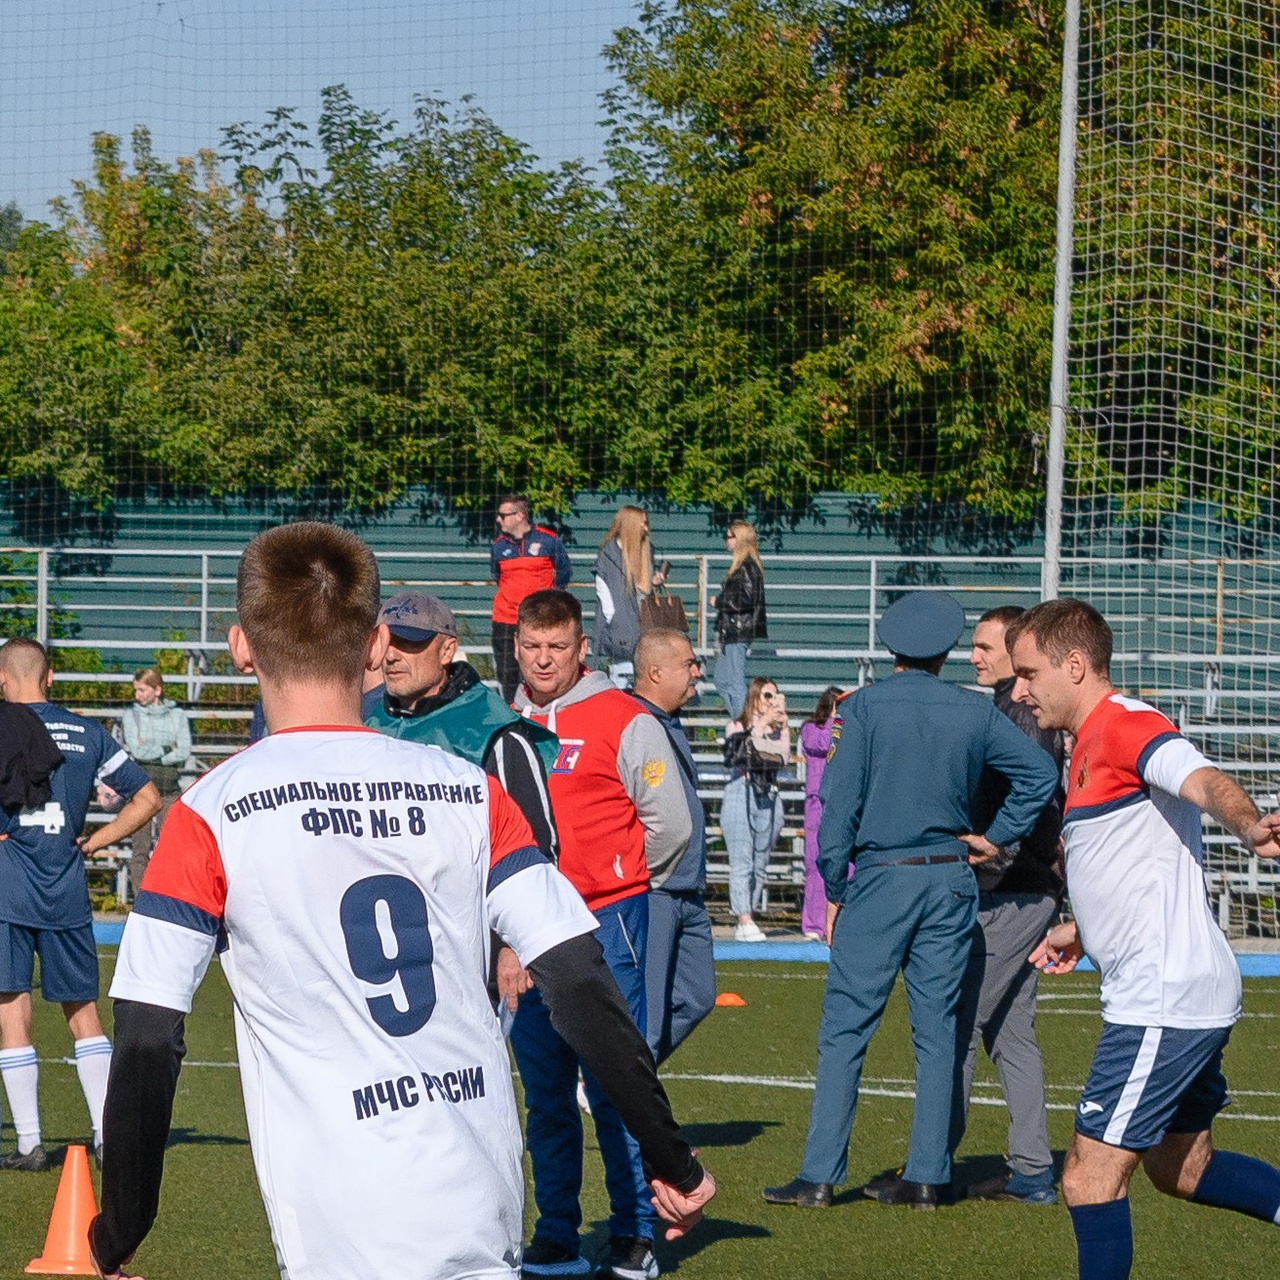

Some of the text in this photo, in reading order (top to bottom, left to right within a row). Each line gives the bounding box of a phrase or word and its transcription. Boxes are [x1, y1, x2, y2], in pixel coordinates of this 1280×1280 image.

[223, 780, 484, 823] СПЕЦИАЛЬНОЕ УПРАВЛЕНИЕ
[300, 806, 426, 838] ФПС № 8
[339, 874, 437, 1037] 9
[352, 1075, 420, 1120] МЧС
